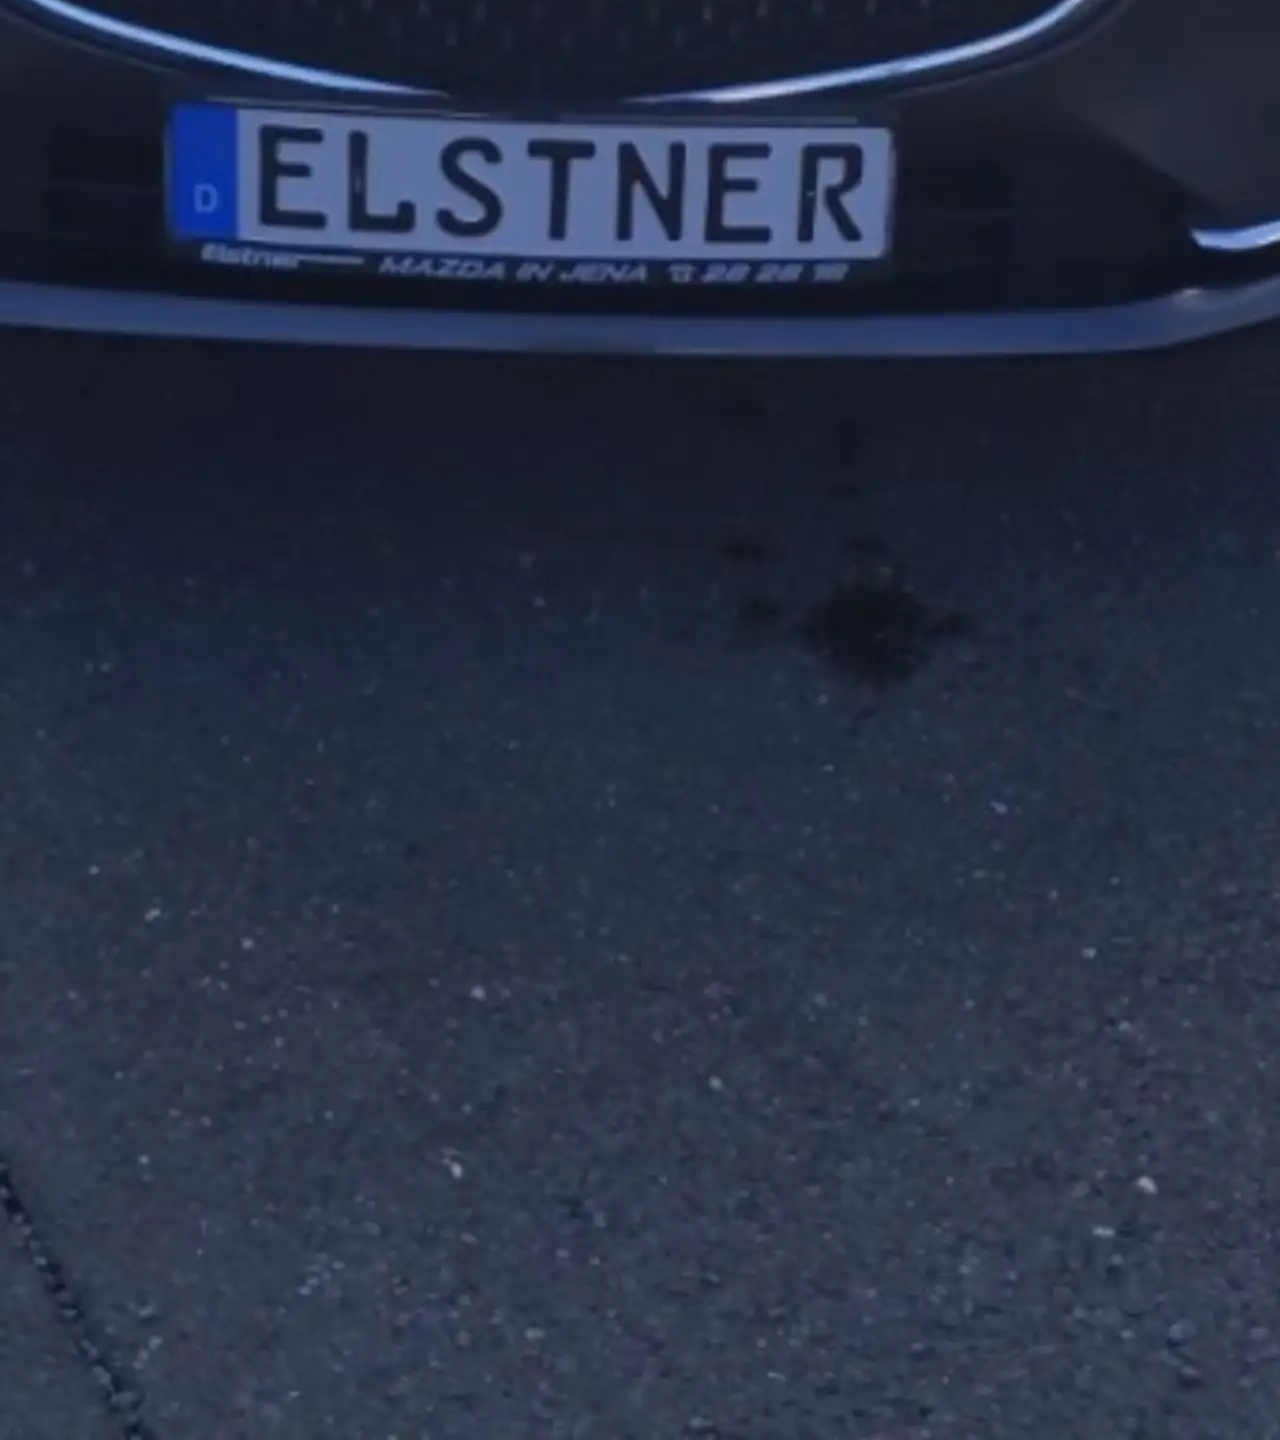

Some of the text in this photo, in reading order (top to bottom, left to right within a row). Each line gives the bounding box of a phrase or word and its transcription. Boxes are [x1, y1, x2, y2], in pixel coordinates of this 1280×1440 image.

[192, 183, 219, 215] D
[257, 124, 866, 245] ELSTNER
[377, 255, 508, 281] MAZDA
[559, 262, 648, 284] JENA
